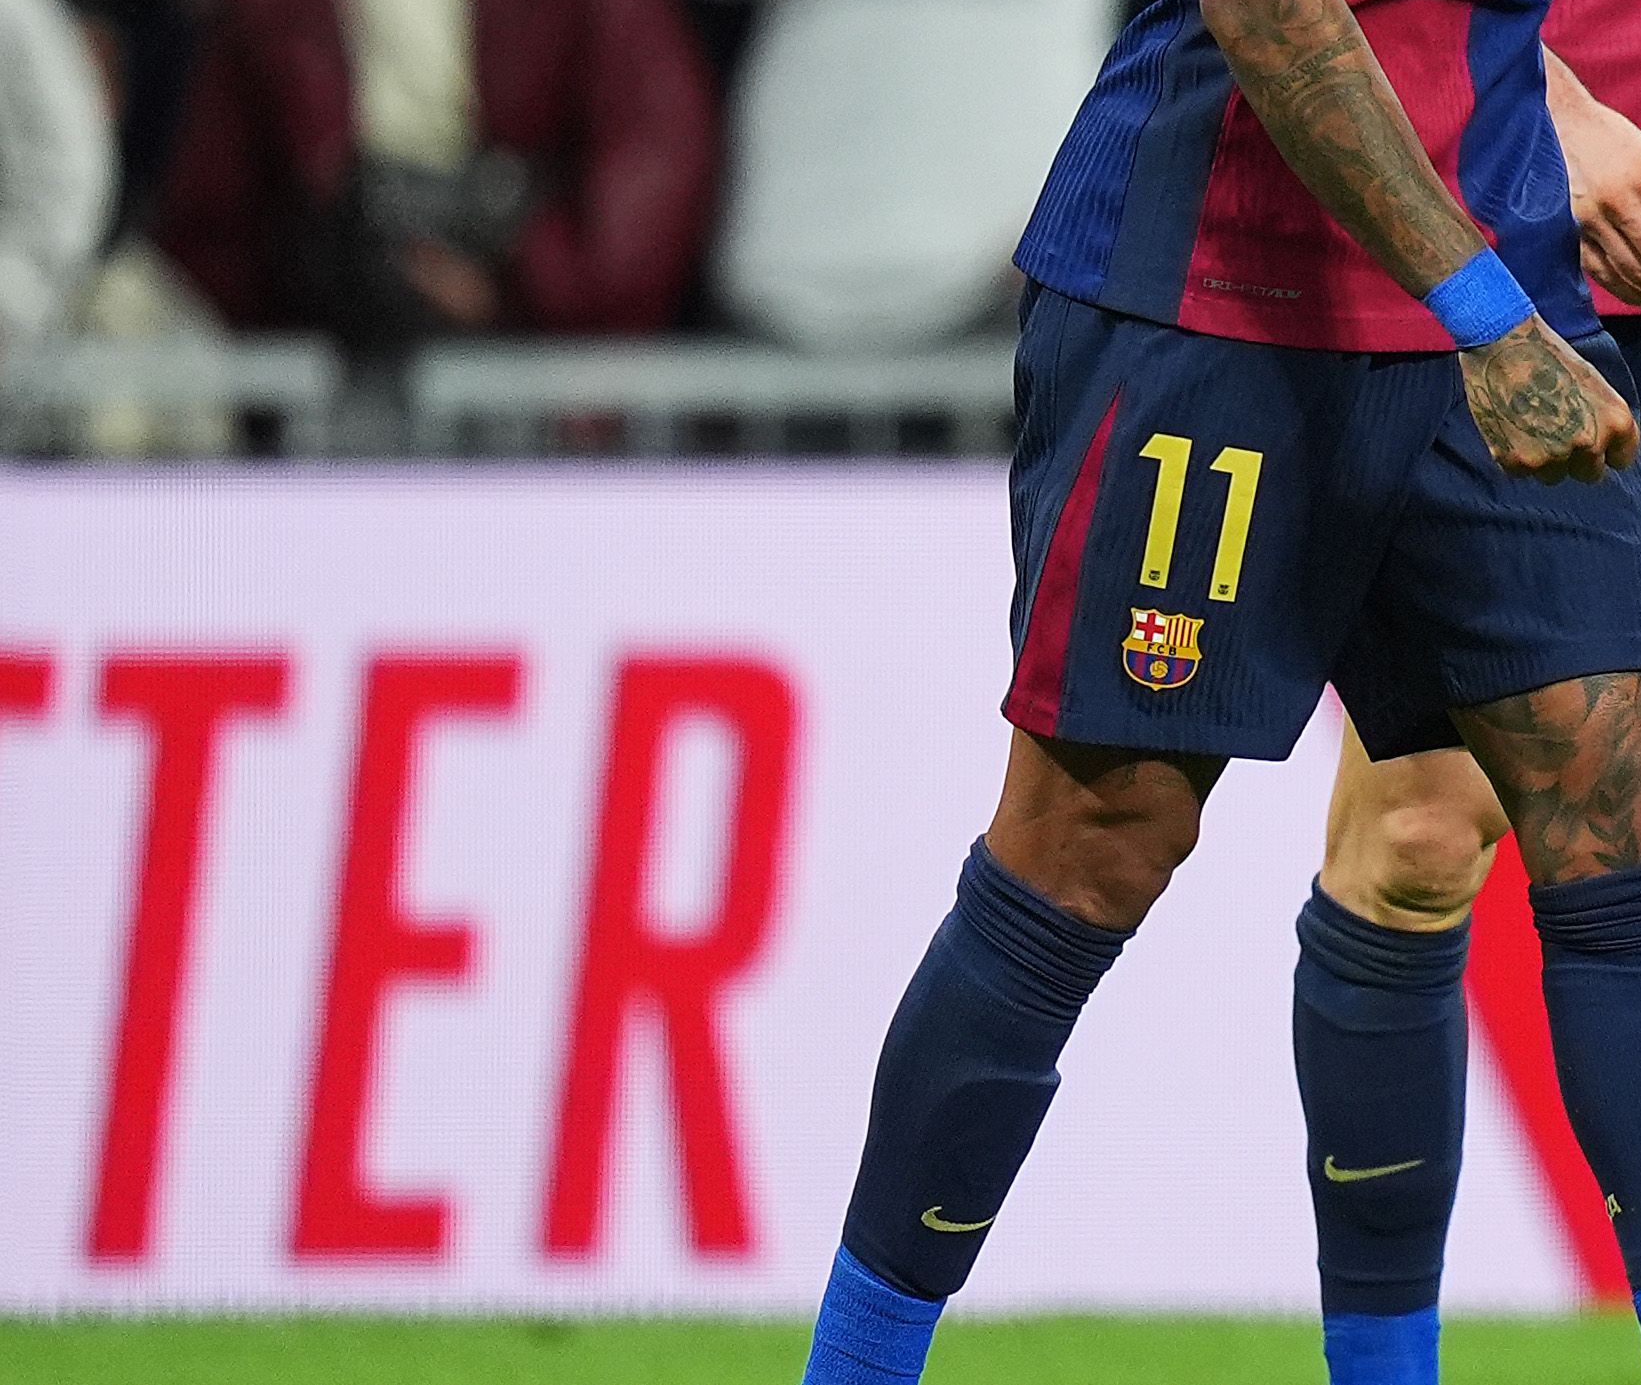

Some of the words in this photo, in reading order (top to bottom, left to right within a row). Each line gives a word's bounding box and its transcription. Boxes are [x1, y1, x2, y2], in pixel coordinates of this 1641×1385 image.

[1138, 433, 1264, 603] 11
[1146, 642, 1178, 656] FCB
[0, 650, 805, 1268] TER
